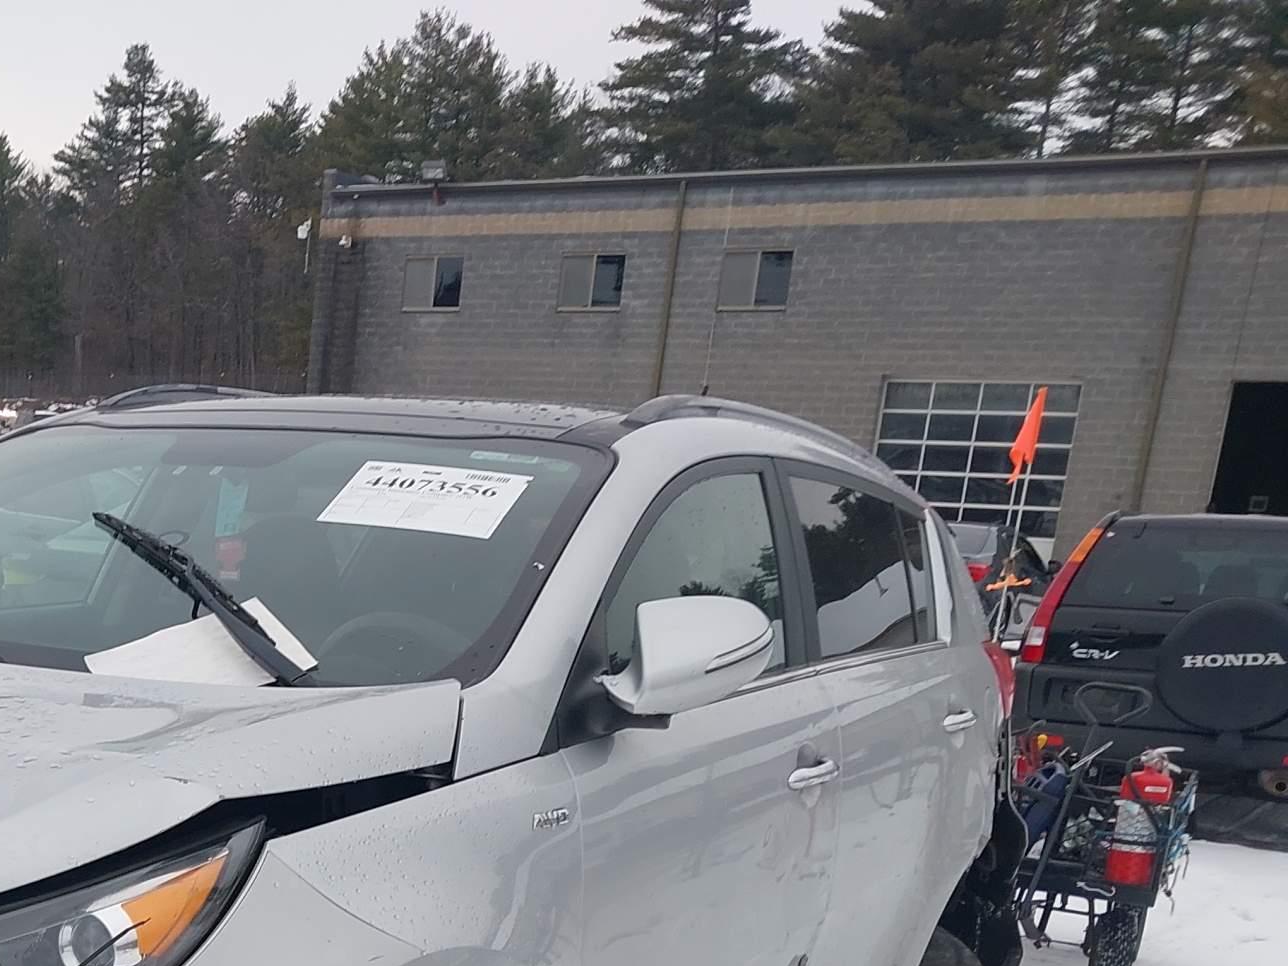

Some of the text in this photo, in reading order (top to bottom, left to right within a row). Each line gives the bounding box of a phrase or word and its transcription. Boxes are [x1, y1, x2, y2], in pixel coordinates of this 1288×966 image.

[366, 475, 498, 498] 44073556
[1072, 647, 1120, 660] CR-V
[1182, 653, 1286, 668] HONDA
